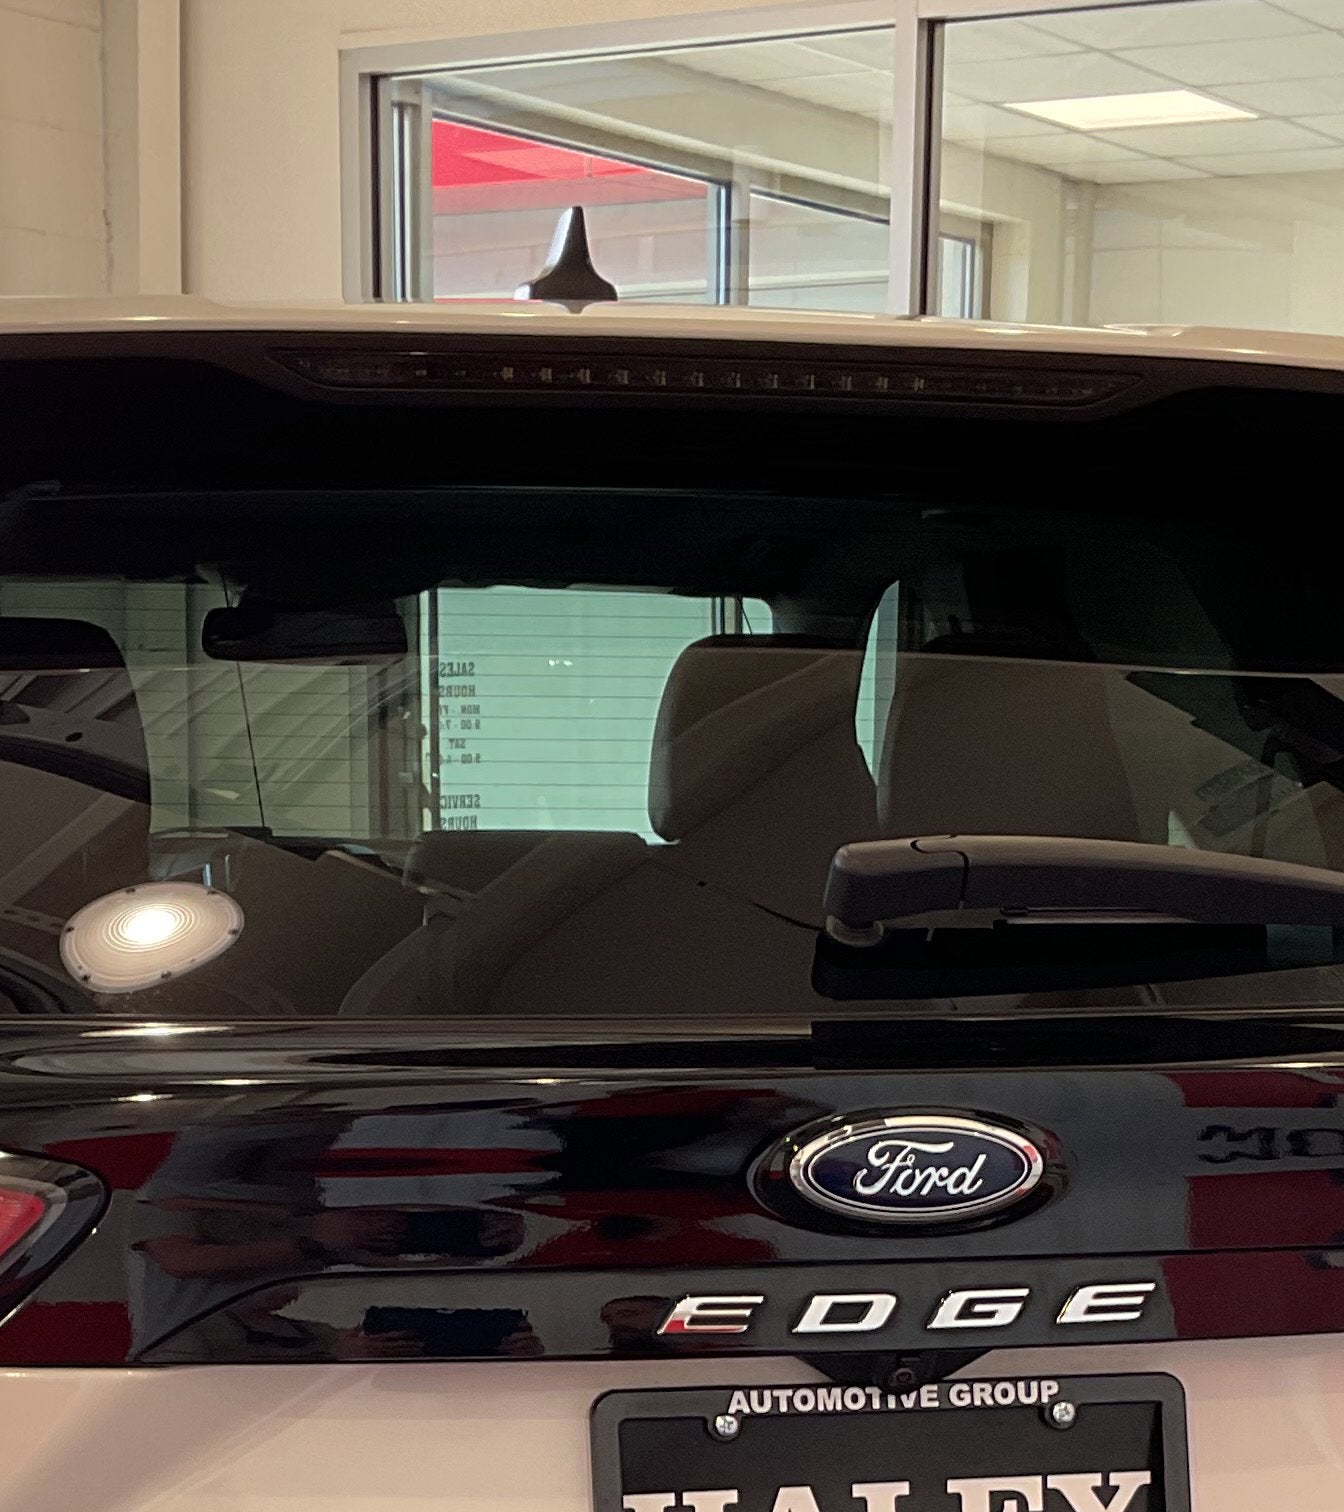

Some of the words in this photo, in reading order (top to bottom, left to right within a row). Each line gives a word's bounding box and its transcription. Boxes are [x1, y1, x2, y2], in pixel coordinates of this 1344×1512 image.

[854, 1139, 987, 1196] Ford
[657, 1283, 1156, 1335] EDGE
[728, 1384, 940, 1414] AUTOMOTIVE
[948, 1380, 1059, 1408] GROUP
